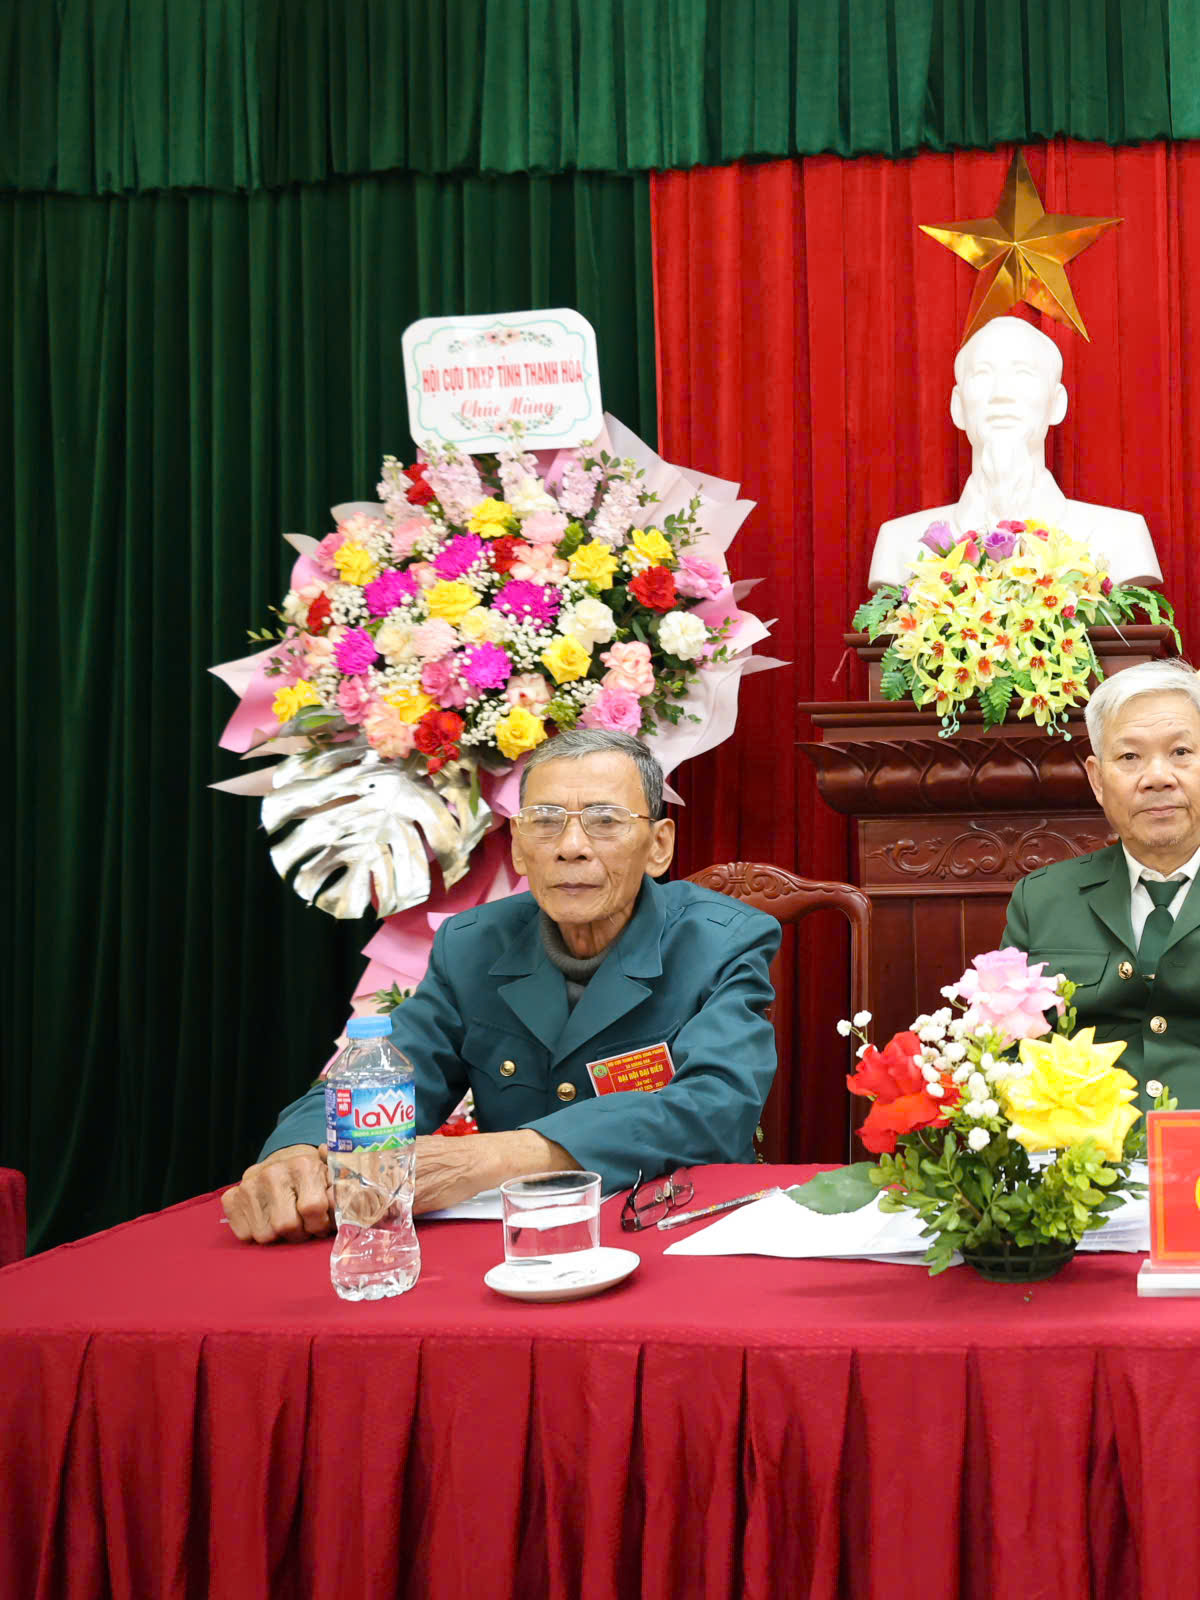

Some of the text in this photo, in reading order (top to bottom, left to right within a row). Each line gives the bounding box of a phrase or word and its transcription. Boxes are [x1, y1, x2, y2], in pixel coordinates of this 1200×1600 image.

[422, 364, 440, 398] HỘI
[466, 366, 494, 390] TNXP
[497, 355, 522, 387] TỈNH
[524, 361, 559, 386] THANH
